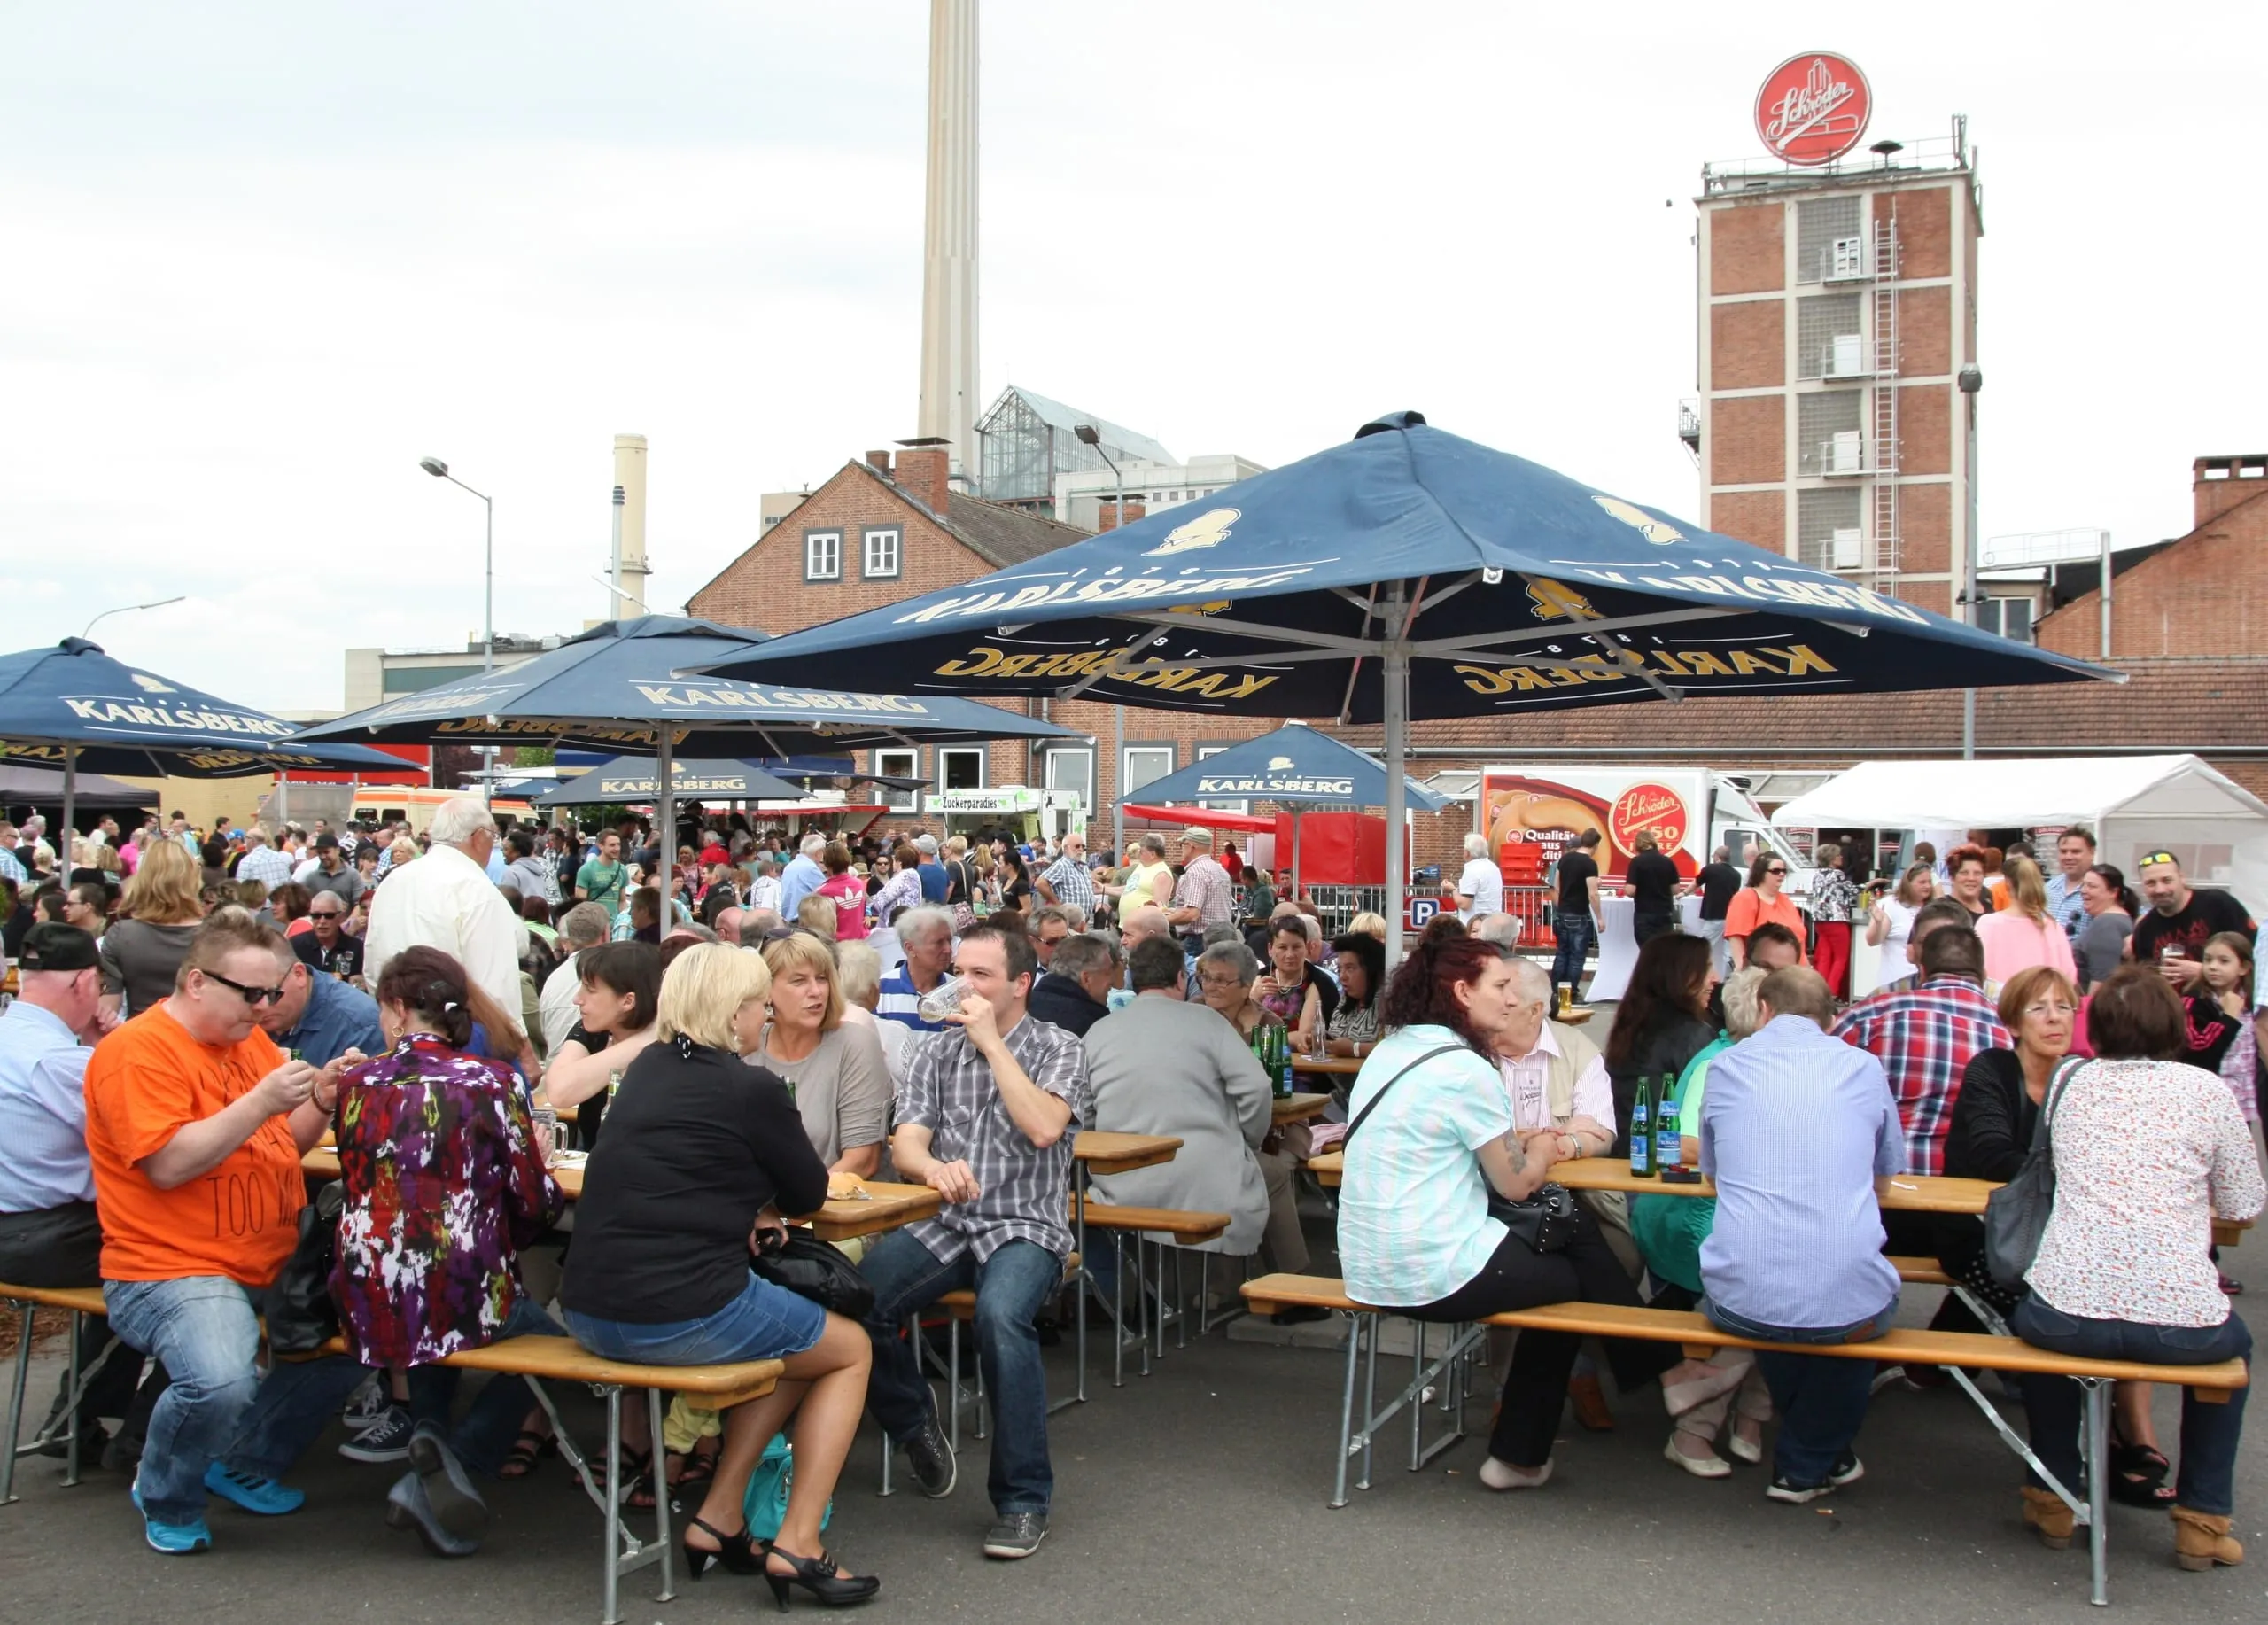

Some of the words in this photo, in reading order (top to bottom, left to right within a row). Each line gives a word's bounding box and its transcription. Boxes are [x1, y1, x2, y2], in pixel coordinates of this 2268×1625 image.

[636, 686, 928, 713] KARLSBERG
[65, 699, 297, 736] KARLSBERG
[1198, 779, 1353, 794] KARLSBERG
[943, 797, 998, 810] Zuckerparadies
[1525, 829, 1575, 841] Qualität
[1640, 825, 1679, 840] 50
[1417, 902, 1433, 924] P
[206, 1170, 265, 1238] TOO
